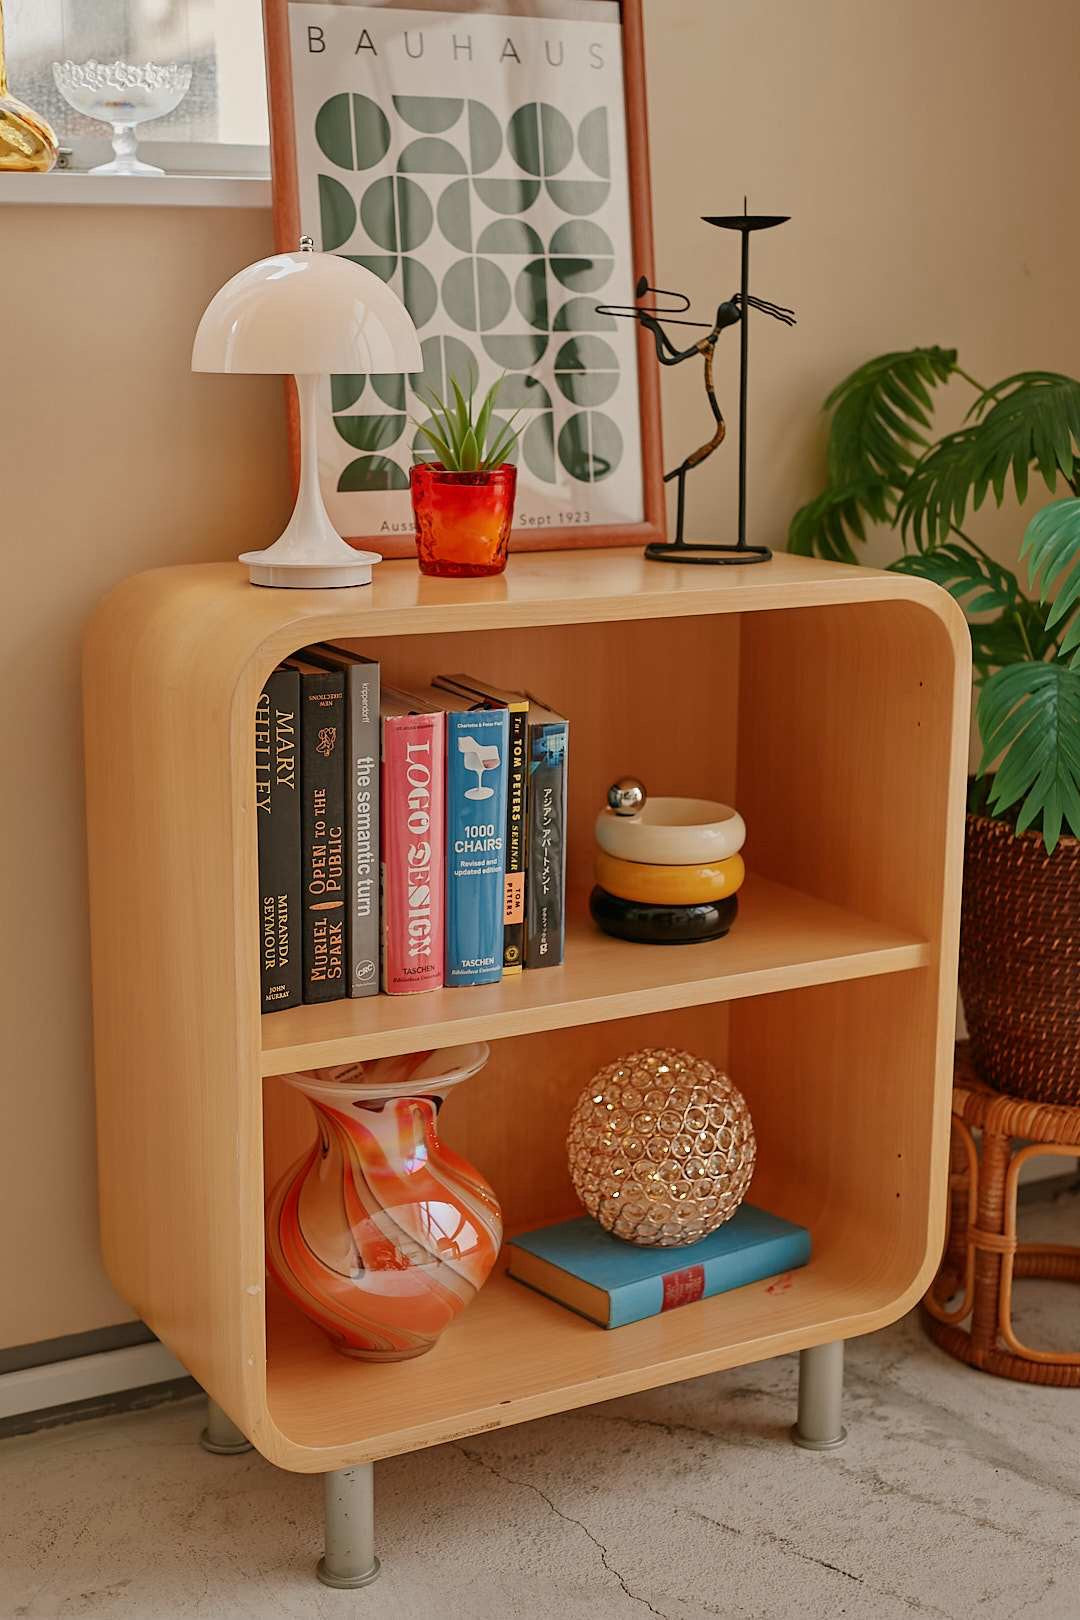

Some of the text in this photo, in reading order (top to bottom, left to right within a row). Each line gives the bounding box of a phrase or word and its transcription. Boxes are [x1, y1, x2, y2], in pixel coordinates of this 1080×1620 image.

[307, 26, 605, 69] BAUHAUS
[519, 511, 591, 529] Sept 1923
[275, 709, 295, 790] MARY
[513, 739, 522, 768] TOM
[406, 741, 431, 835] LOGO
[512, 774, 522, 821] PETERS
[308, 788, 327, 895] OPEN TO THE
[357, 756, 375, 917] the semantic turn
[454, 837, 503, 853] CHAIRS
[464, 824, 495, 838] 1000
[511, 825, 519, 871] SEMINAR
[326, 826, 343, 892] PUBLIC
[454, 866, 502, 877] updated edition
[460, 858, 498, 867] Revised and
[407, 841, 432, 957] DESIGN
[264, 896, 276, 970] SEYMOUR
[278, 894, 289, 968] MIRANDA
[310, 917, 328, 982] MURIEL
[327, 921, 343, 979] SPARK
[402, 964, 436, 975] TASCHEN
[461, 957, 495, 968] TASCHEN
[265, 991, 290, 1001] MURRAY
[269, 984, 286, 994] JOHN
